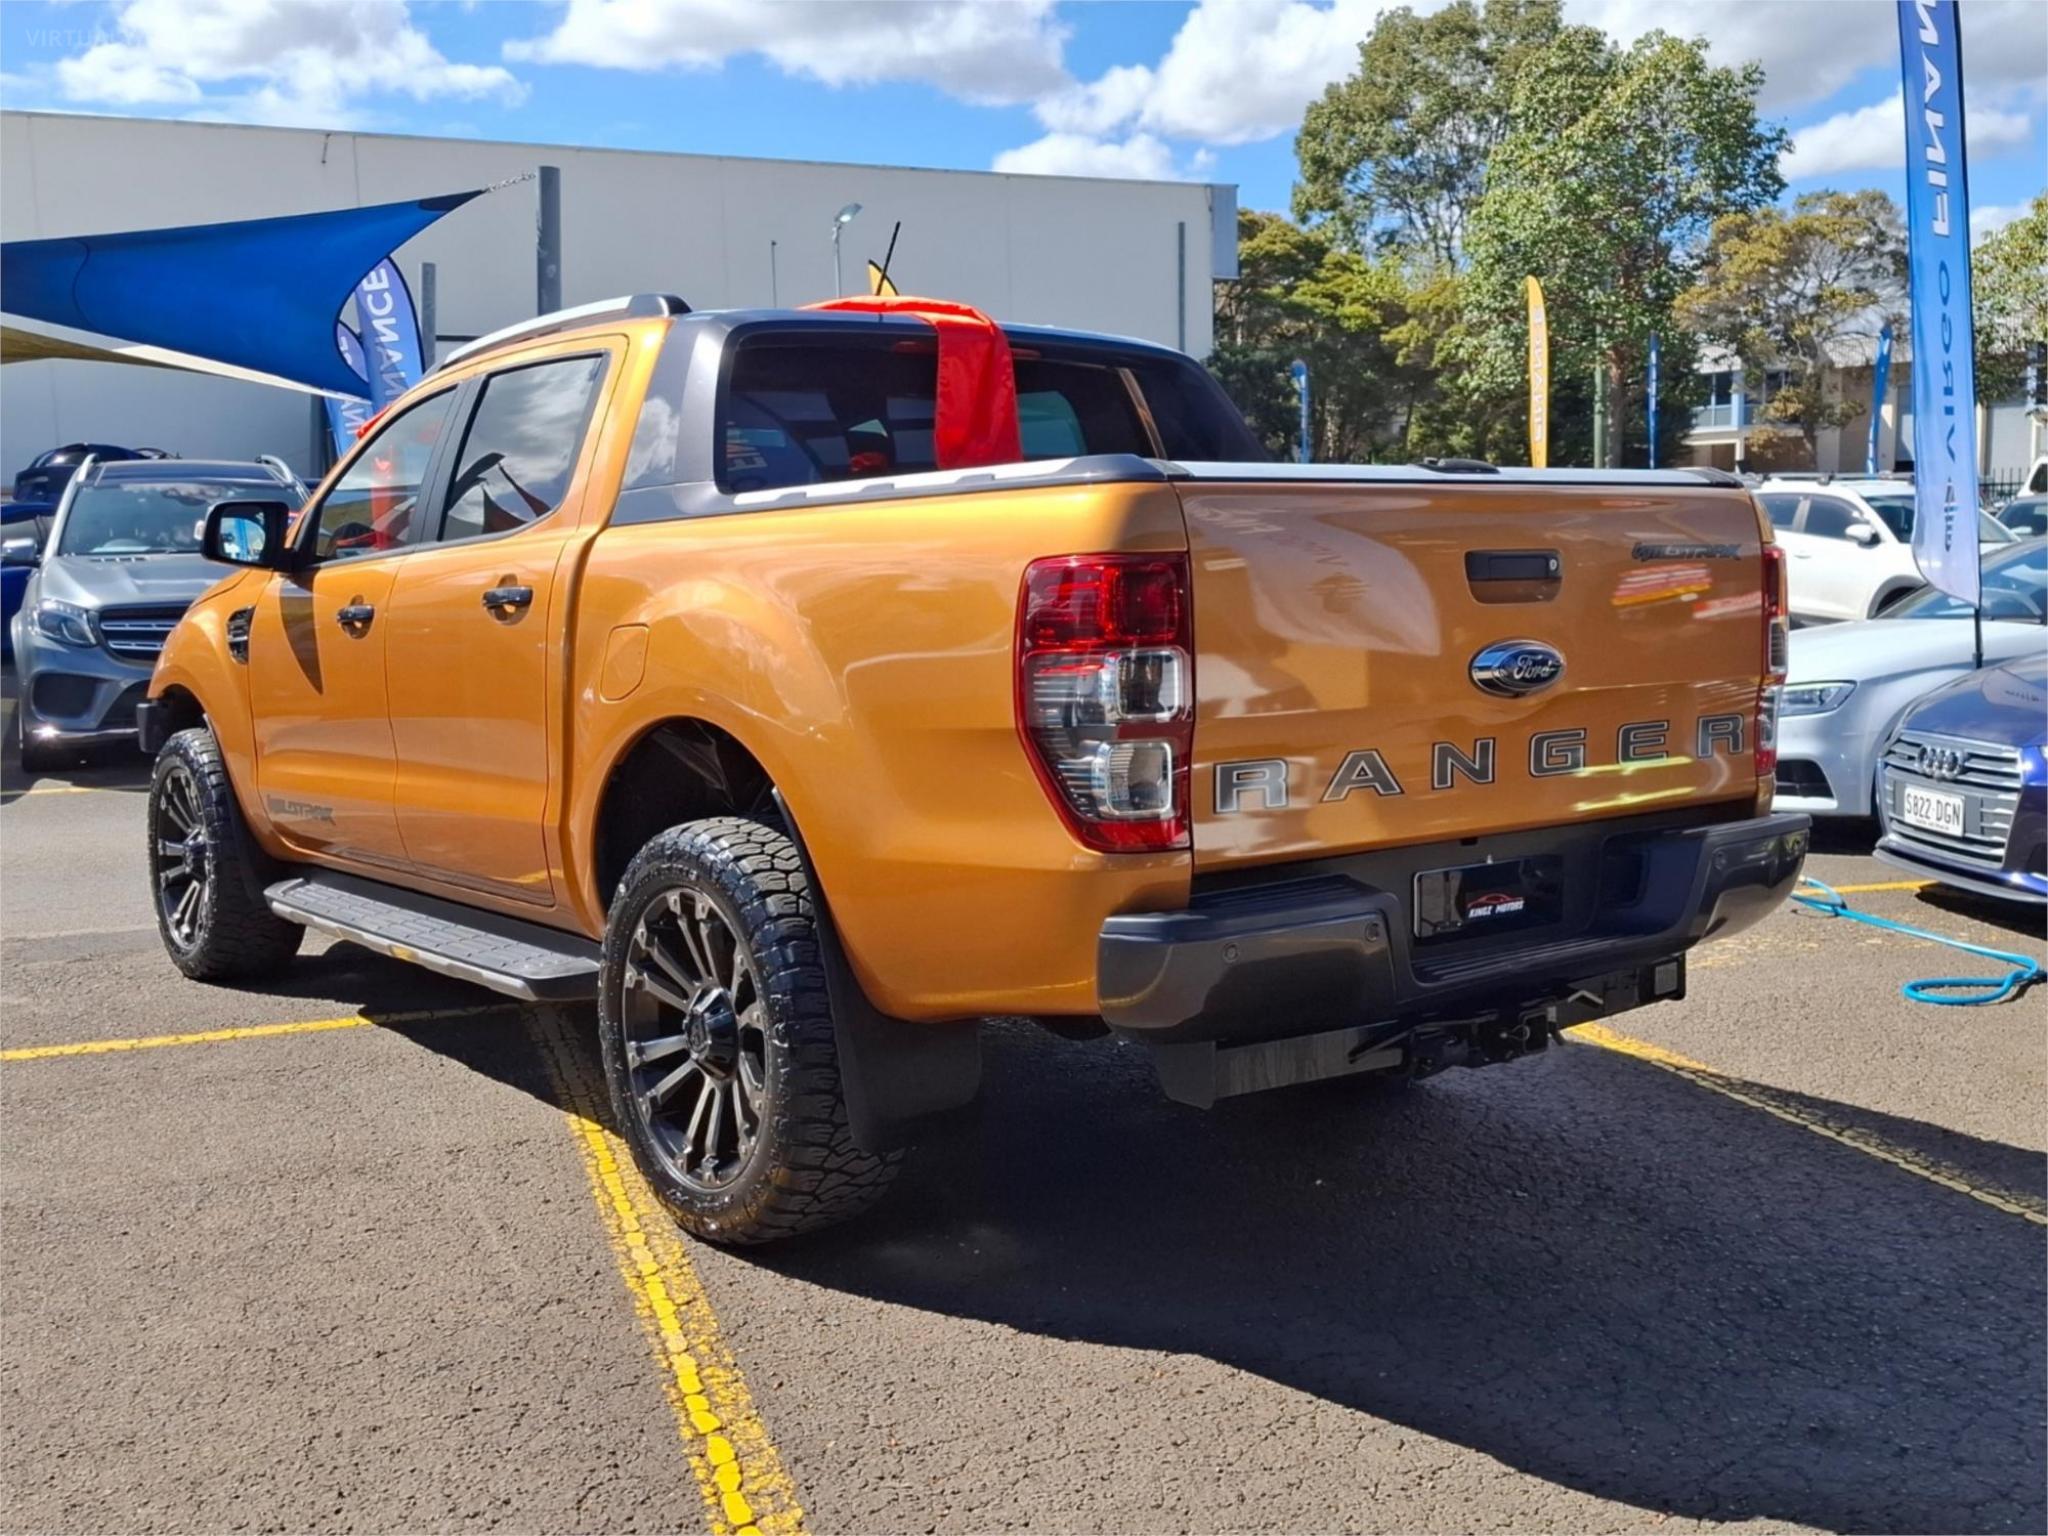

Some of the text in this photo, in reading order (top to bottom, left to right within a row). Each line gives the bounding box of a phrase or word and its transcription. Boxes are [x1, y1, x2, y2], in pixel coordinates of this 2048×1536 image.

[1513, 654, 1560, 680] Ford
[1213, 712, 1746, 815] RANGER
[1936, 799, 1961, 826] DGN
[1495, 900, 1525, 914] MOTORS
